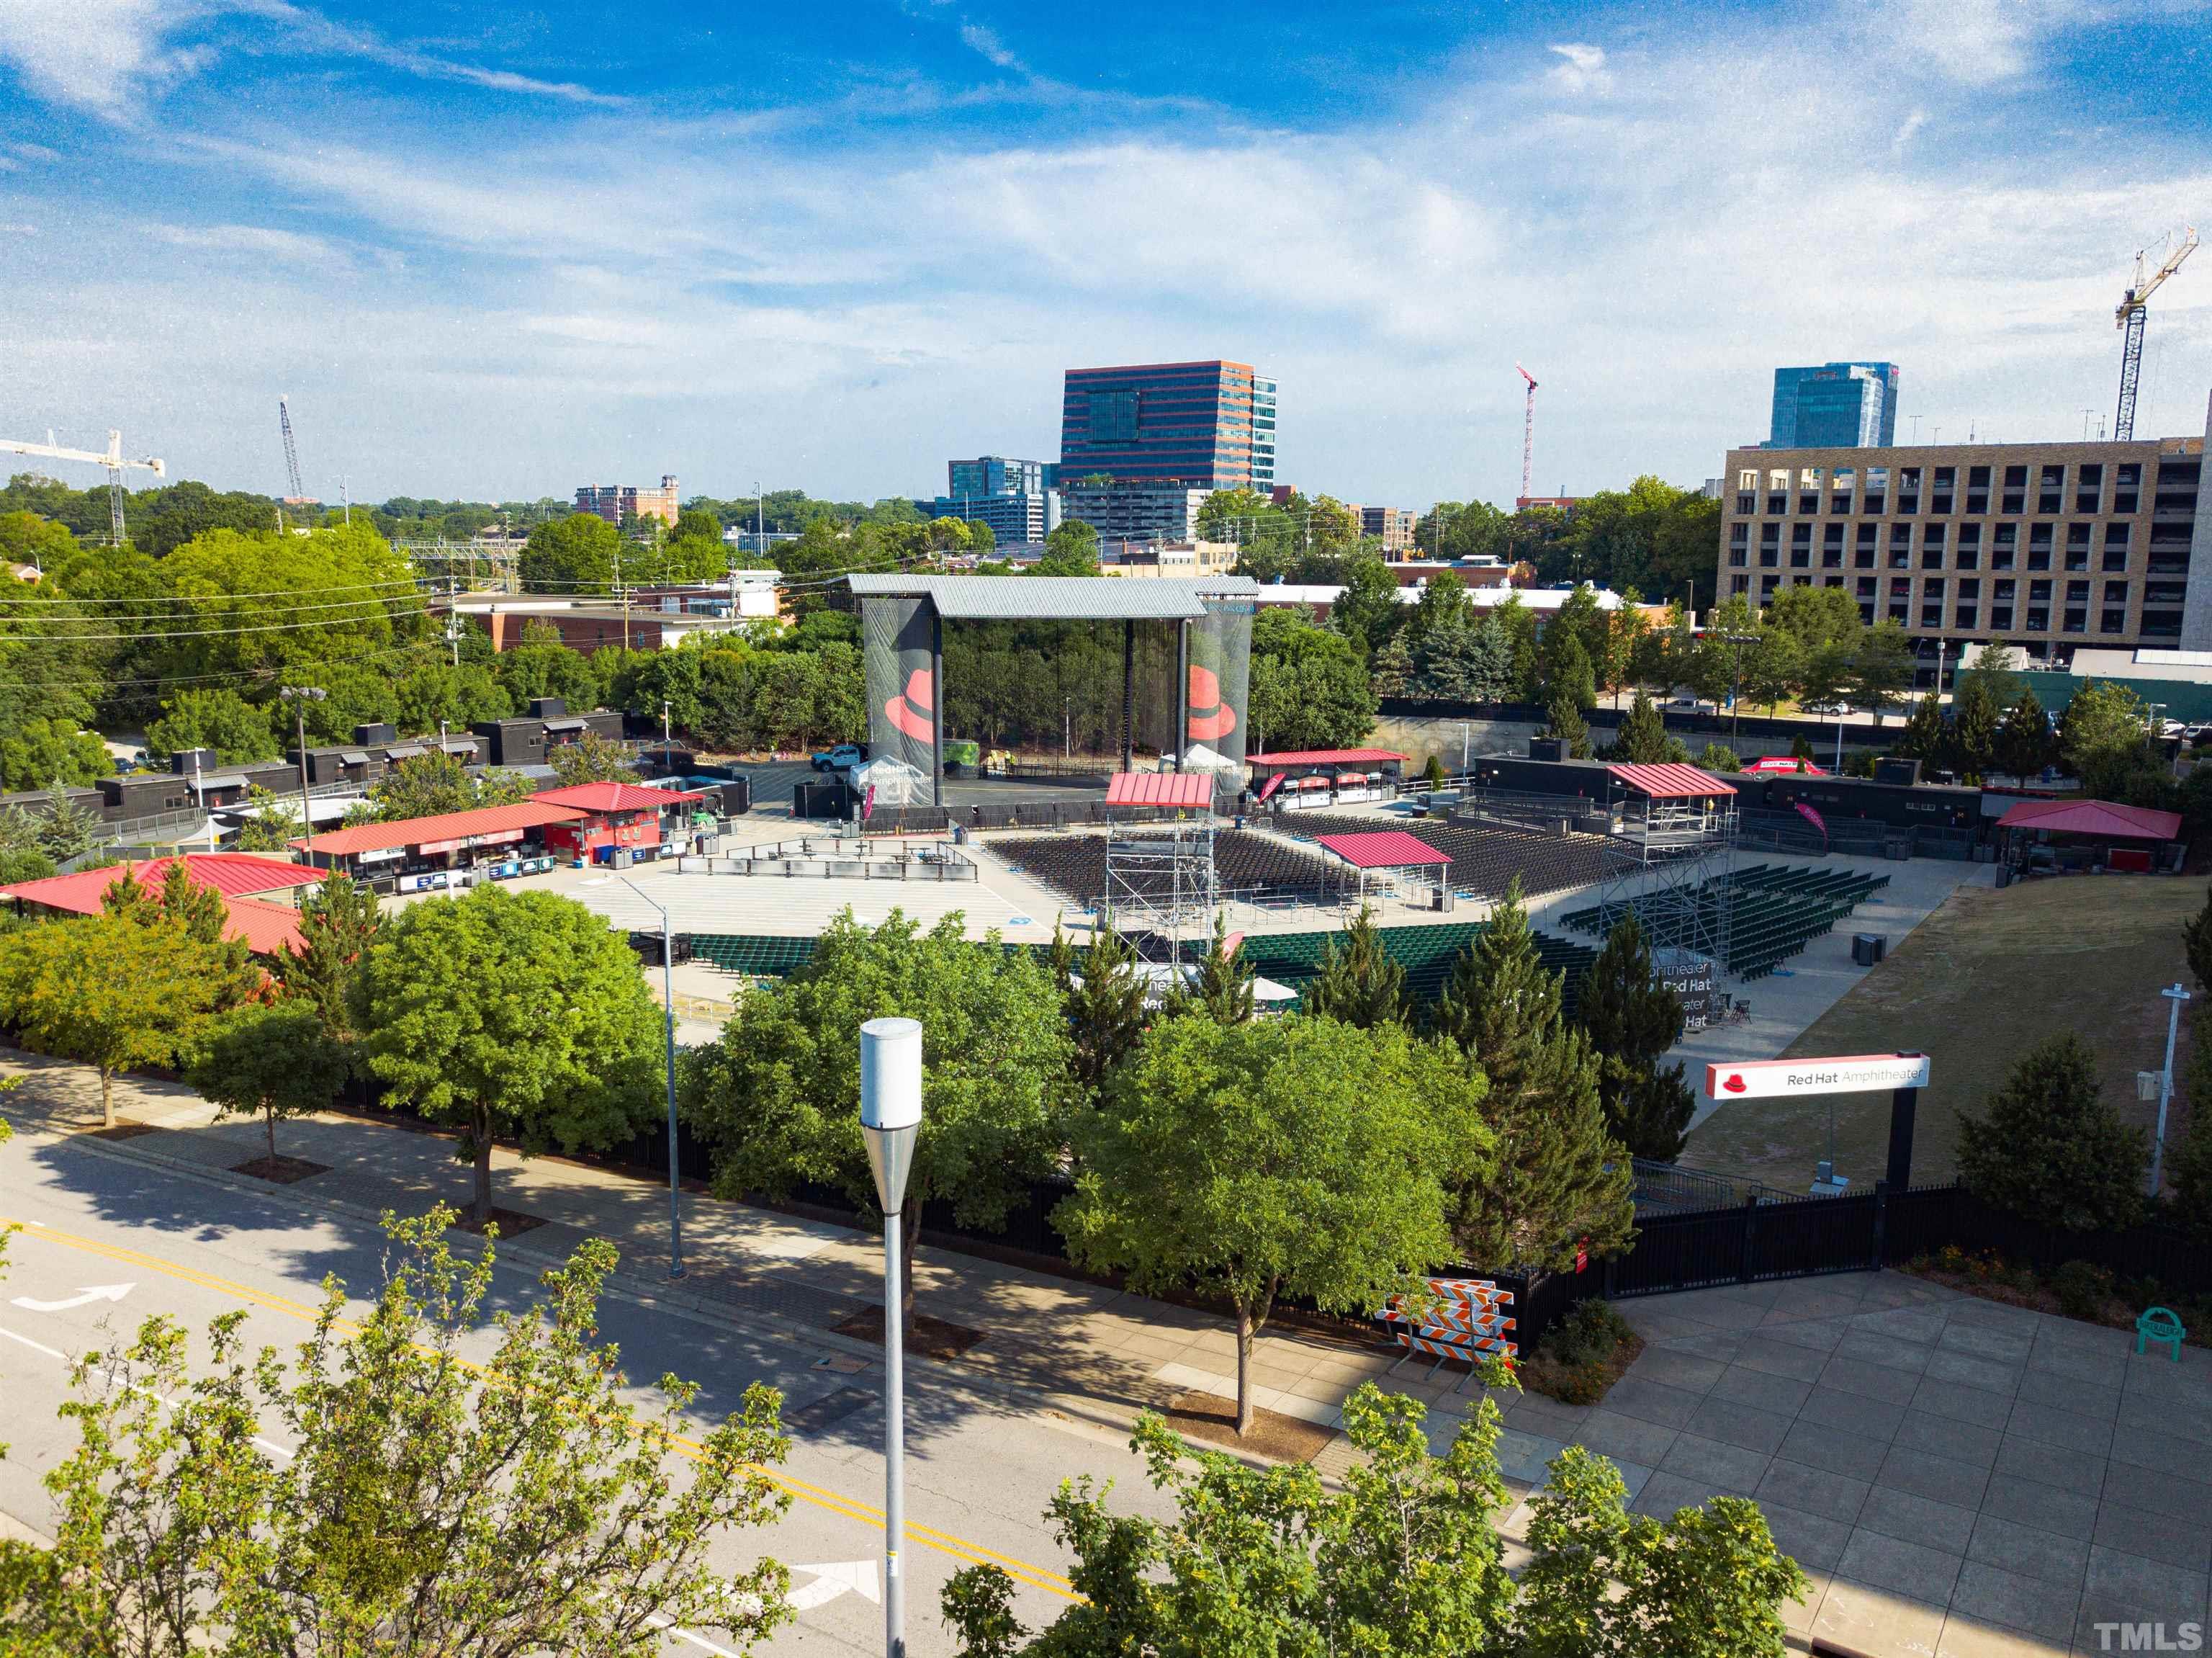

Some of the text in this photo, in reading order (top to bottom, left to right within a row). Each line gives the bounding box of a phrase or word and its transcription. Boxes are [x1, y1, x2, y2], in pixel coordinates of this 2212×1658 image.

[1689, 978, 1712, 992] Hat
[1686, 1015, 1707, 1028] Hat
[1787, 1068, 1923, 1086] Red Hat Amphitheater
